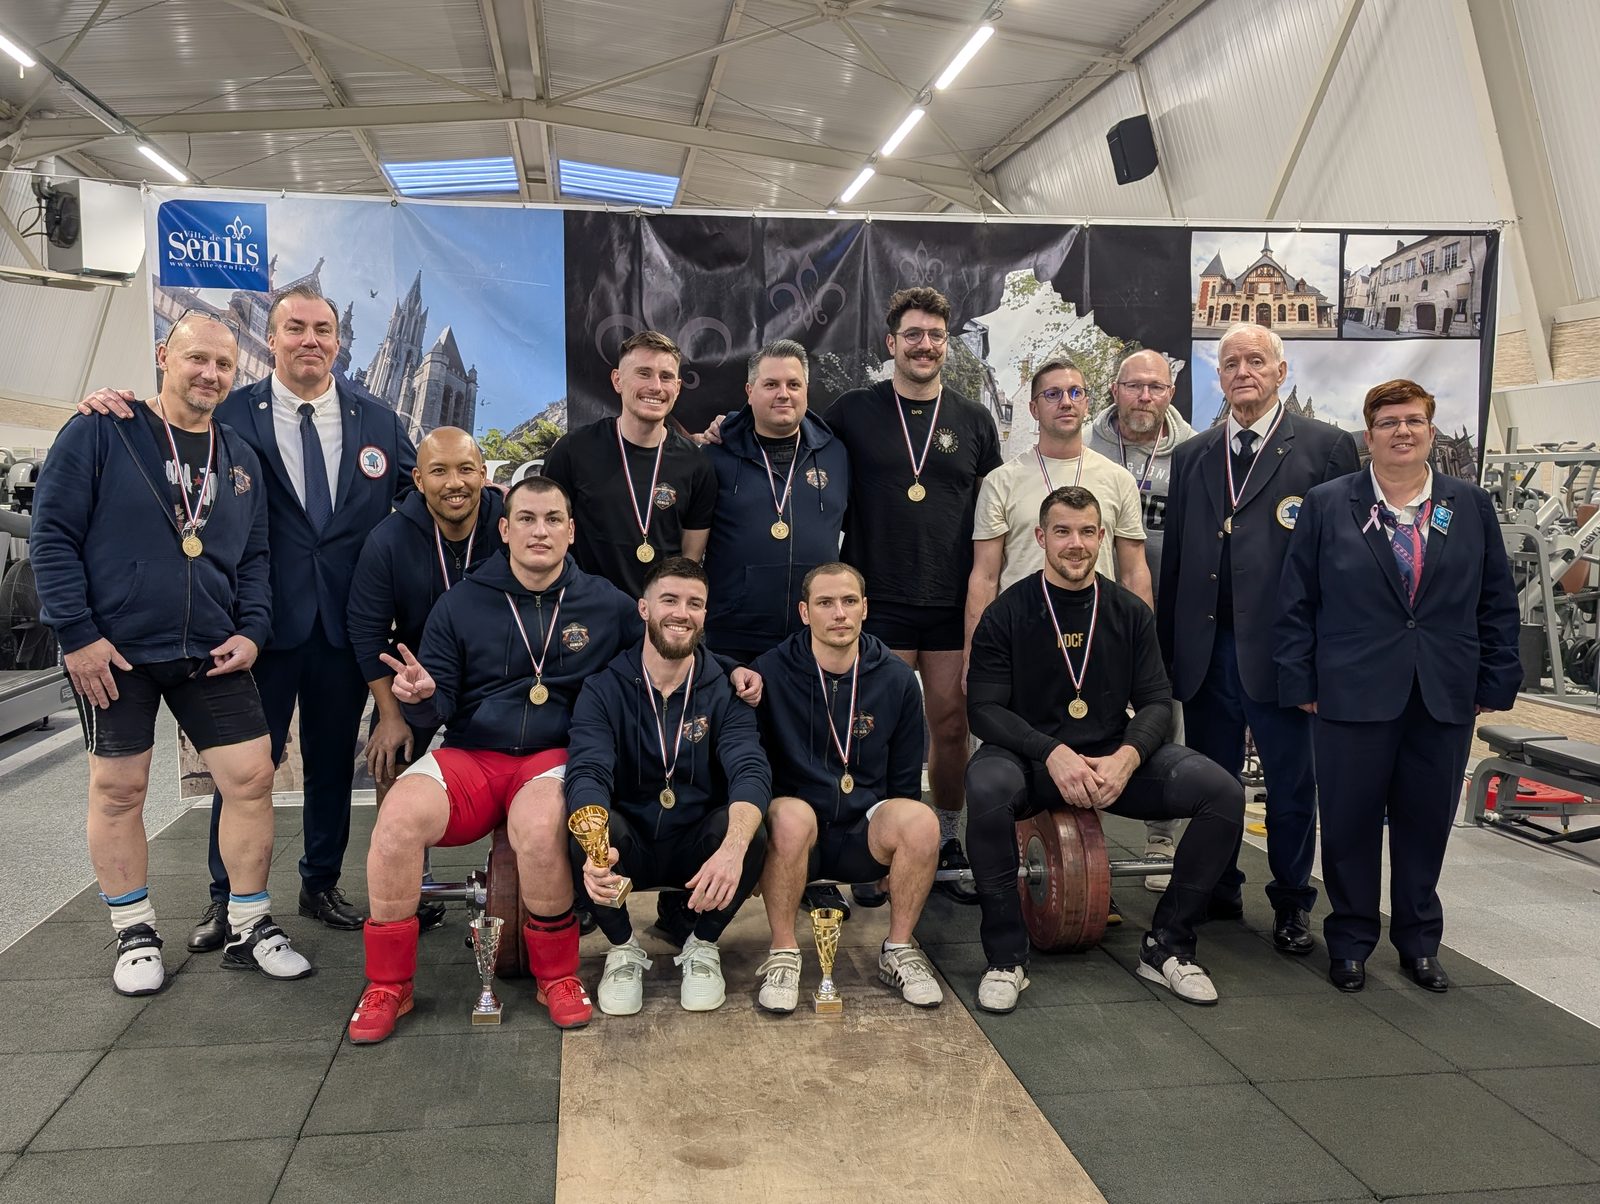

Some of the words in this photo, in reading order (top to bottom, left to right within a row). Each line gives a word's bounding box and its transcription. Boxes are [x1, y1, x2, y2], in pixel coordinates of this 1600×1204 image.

[184, 230, 206, 239] Ville
[209, 233, 221, 241] de
[168, 232, 259, 266] Senlis
[169, 261, 260, 272] www.ville-senlis.fr
